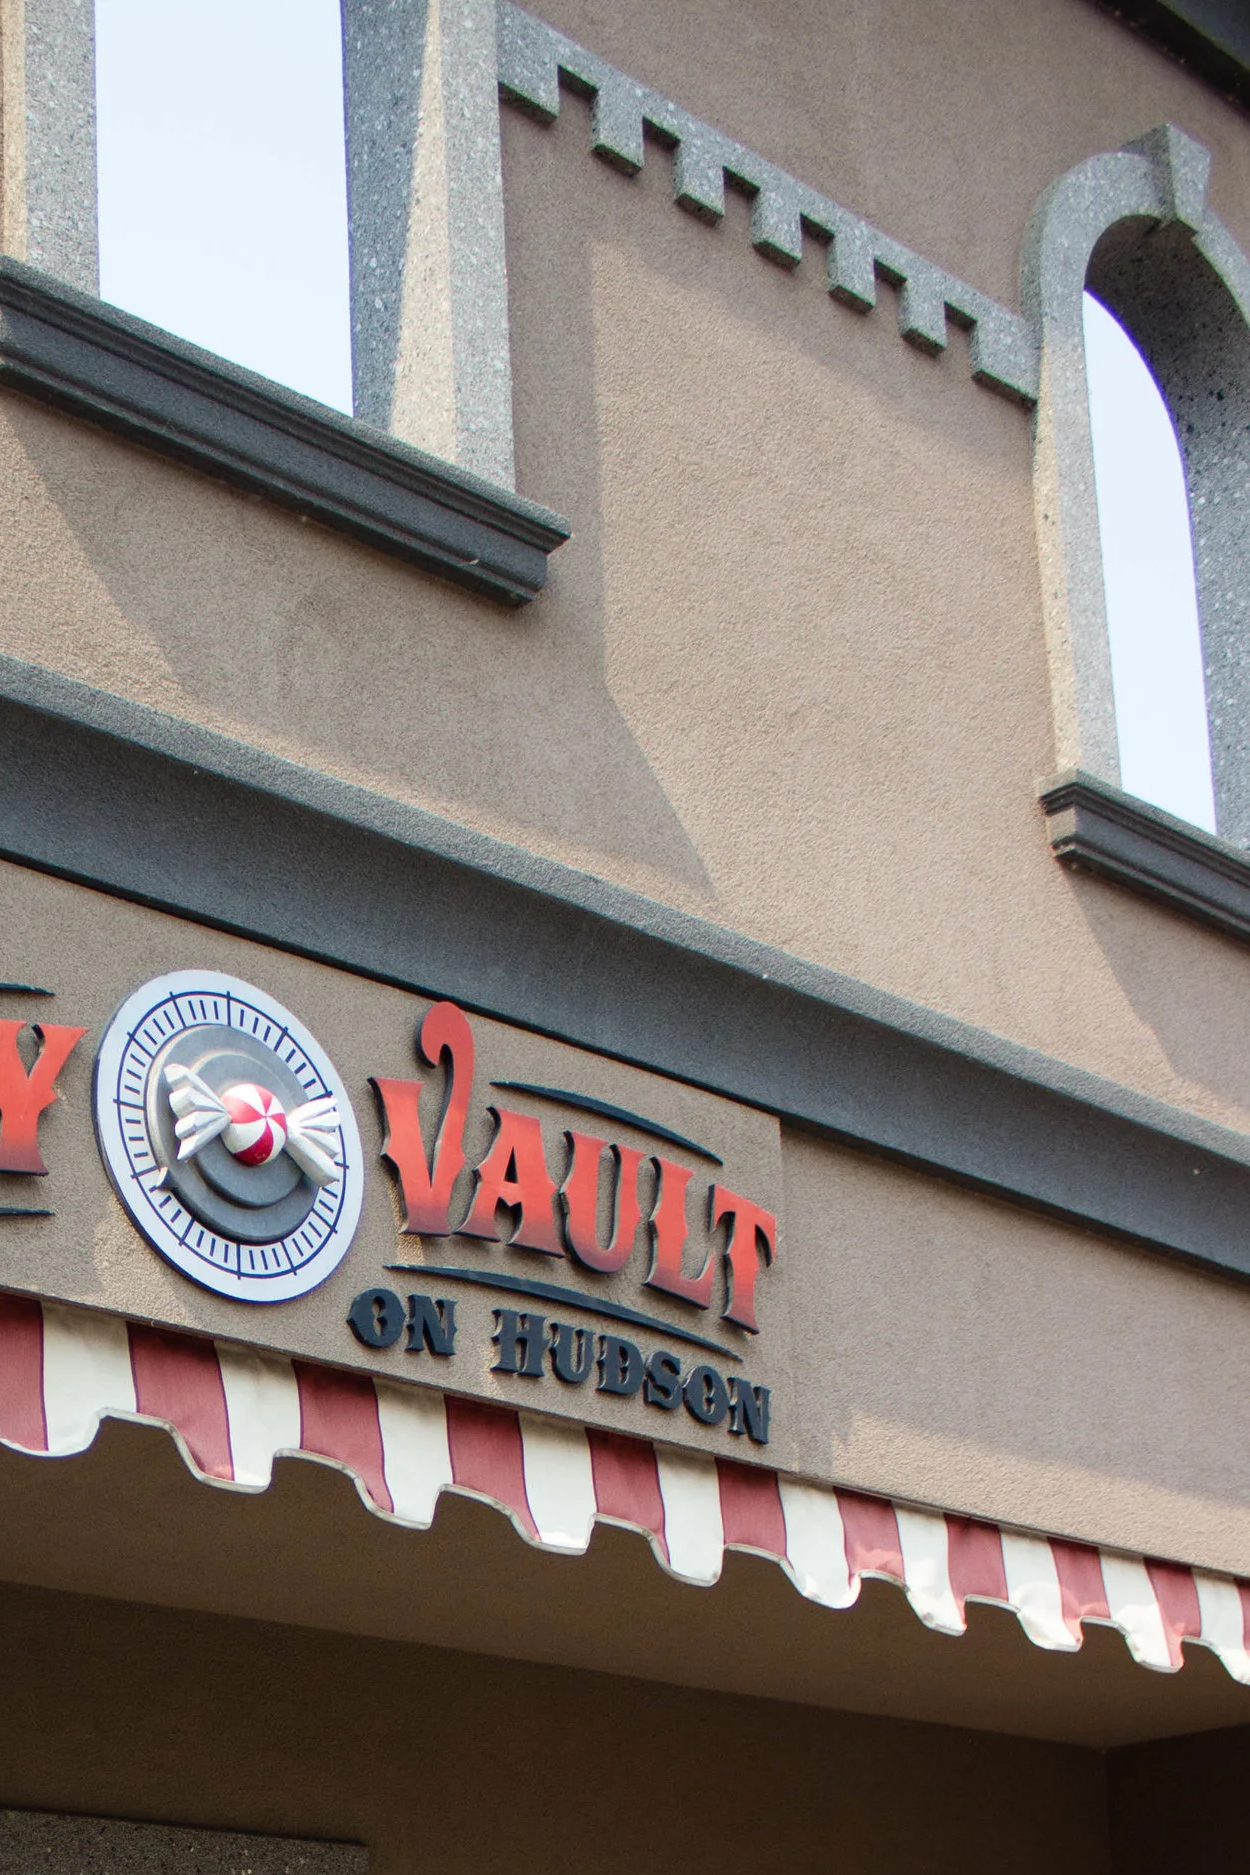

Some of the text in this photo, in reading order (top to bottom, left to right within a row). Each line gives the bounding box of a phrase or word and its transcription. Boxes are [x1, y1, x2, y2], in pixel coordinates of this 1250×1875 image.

[367, 1000, 778, 1334] VAULT
[346, 1287, 772, 1445] ON HUDSON
